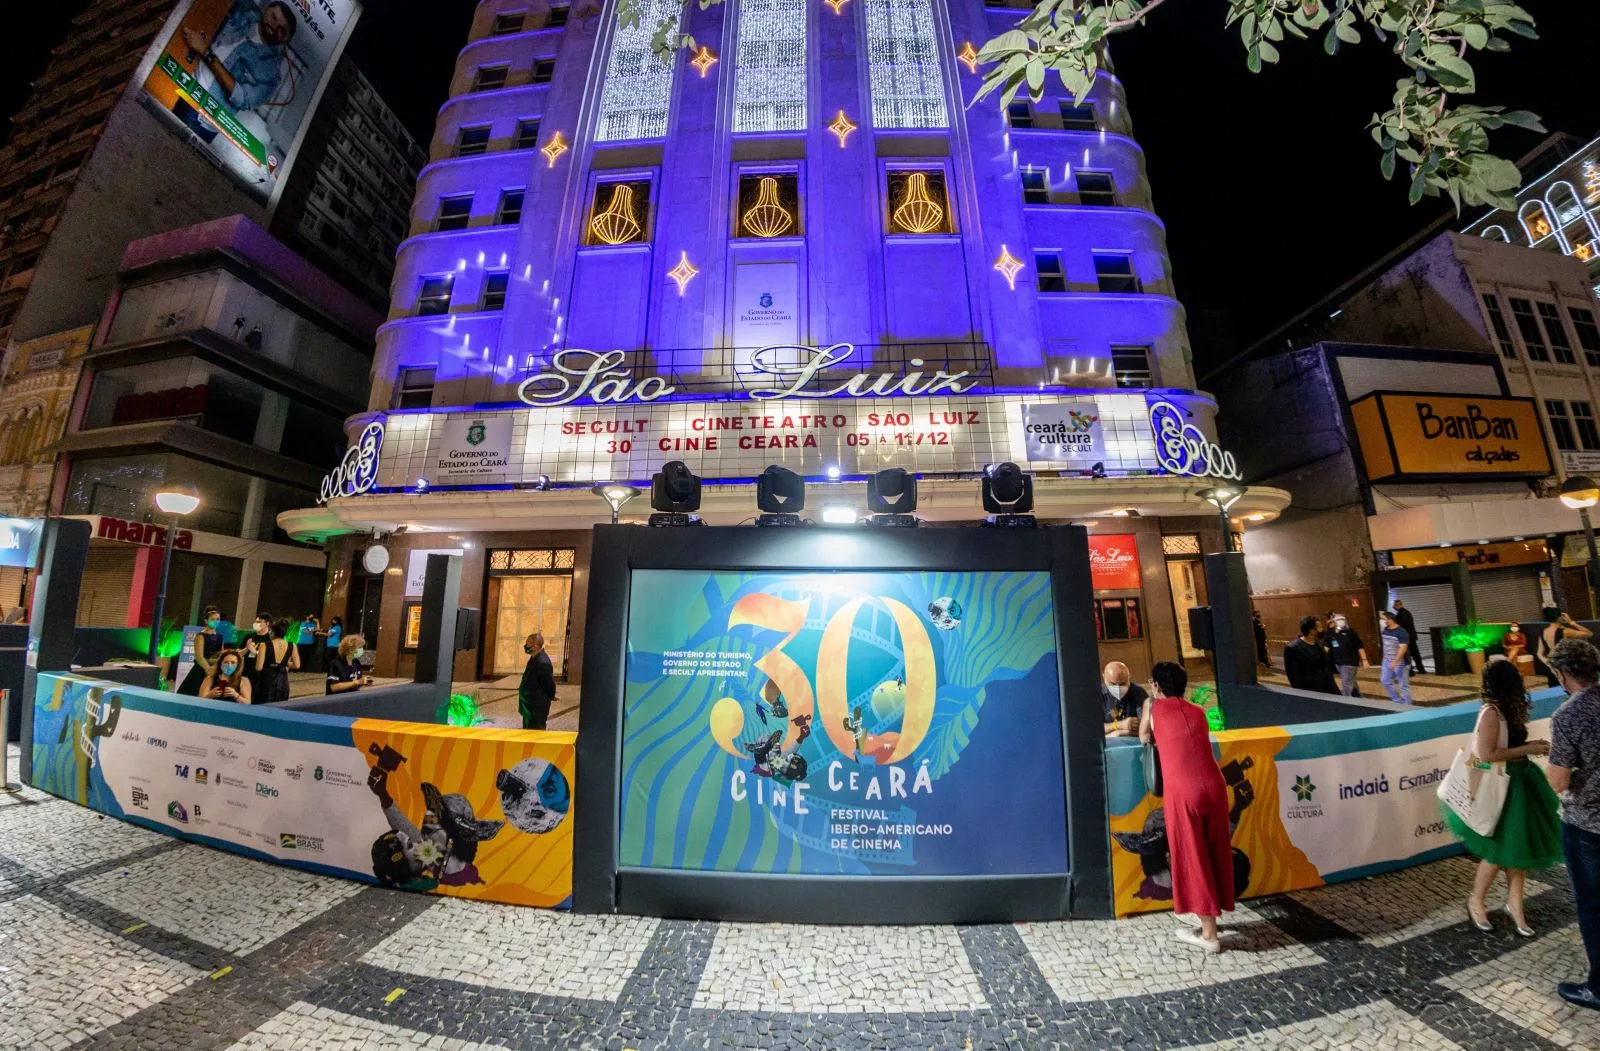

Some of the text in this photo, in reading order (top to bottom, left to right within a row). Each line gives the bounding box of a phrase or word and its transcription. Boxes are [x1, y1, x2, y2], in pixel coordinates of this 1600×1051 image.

[517, 342, 979, 407] São Luiz
[562, 411, 981, 435] SECULT CINETEATRO SÃO LUIZ
[1026, 420, 1066, 433] ceará
[1416, 402, 1519, 440] BanBan
[658, 436, 718, 451] CINE
[738, 431, 818, 449] CEARÁ
[846, 433, 870, 446] 05
[1039, 432, 1091, 444] cultura
[1062, 445, 1092, 453] SECULT
[1465, 445, 1520, 464] calçados
[663, 650, 705, 658] MINISTÉRIO
[718, 652, 753, 660] TURISMO,
[709, 592, 937, 766] 30
[255, 782, 279, 798] Diário
[731, 758, 933, 815] CINE CEARÁ
[1339, 773, 1389, 800] indaiá
[831, 808, 889, 820] FESTIVAL
[1287, 809, 1324, 819] CULTURA
[831, 824, 953, 836] IBERO-AMERICANO
[297, 839, 324, 851] BRASIL
[831, 838, 902, 851] DE CINEMA
